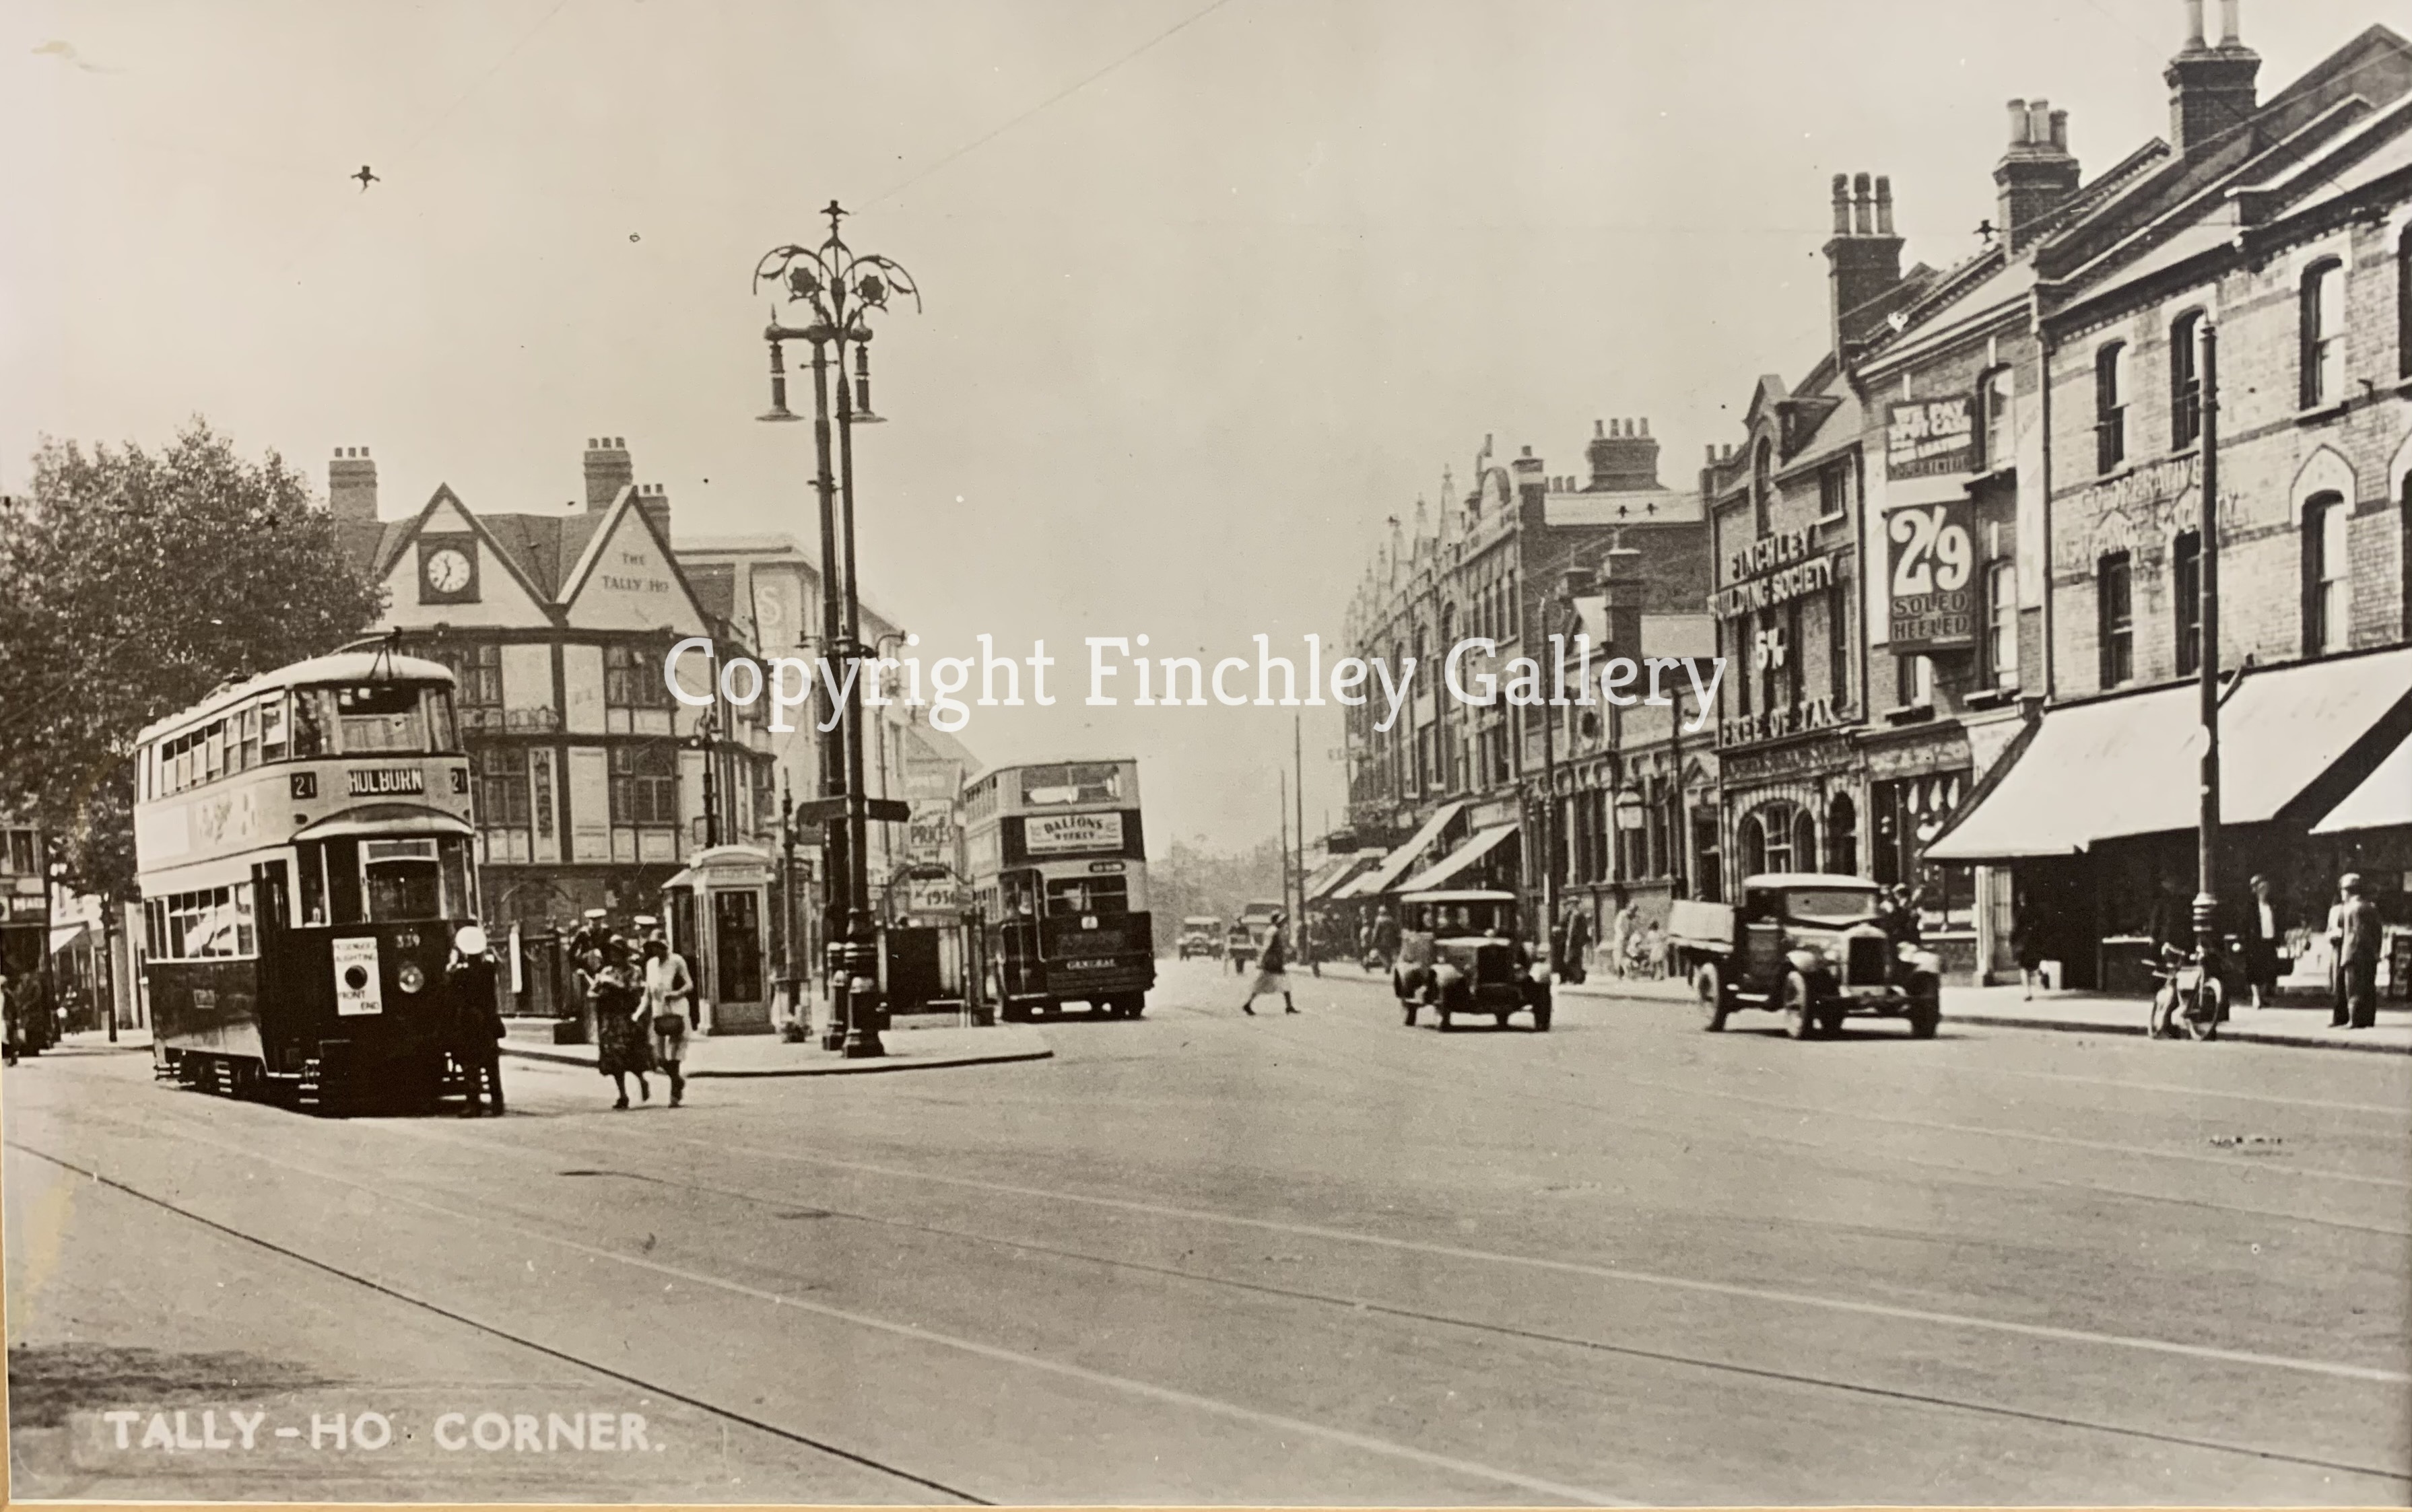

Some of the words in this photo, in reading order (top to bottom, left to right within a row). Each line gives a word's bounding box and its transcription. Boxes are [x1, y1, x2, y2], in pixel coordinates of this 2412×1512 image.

[622, 553, 645, 565] THE
[1729, 522, 1813, 580] FINCHLEY
[1889, 505, 1972, 594] 2/9
[602, 575, 642, 592] TALLY
[648, 579, 669, 592] HO
[1772, 552, 1837, 605] SOCIETY
[295, 776, 314, 796] 21
